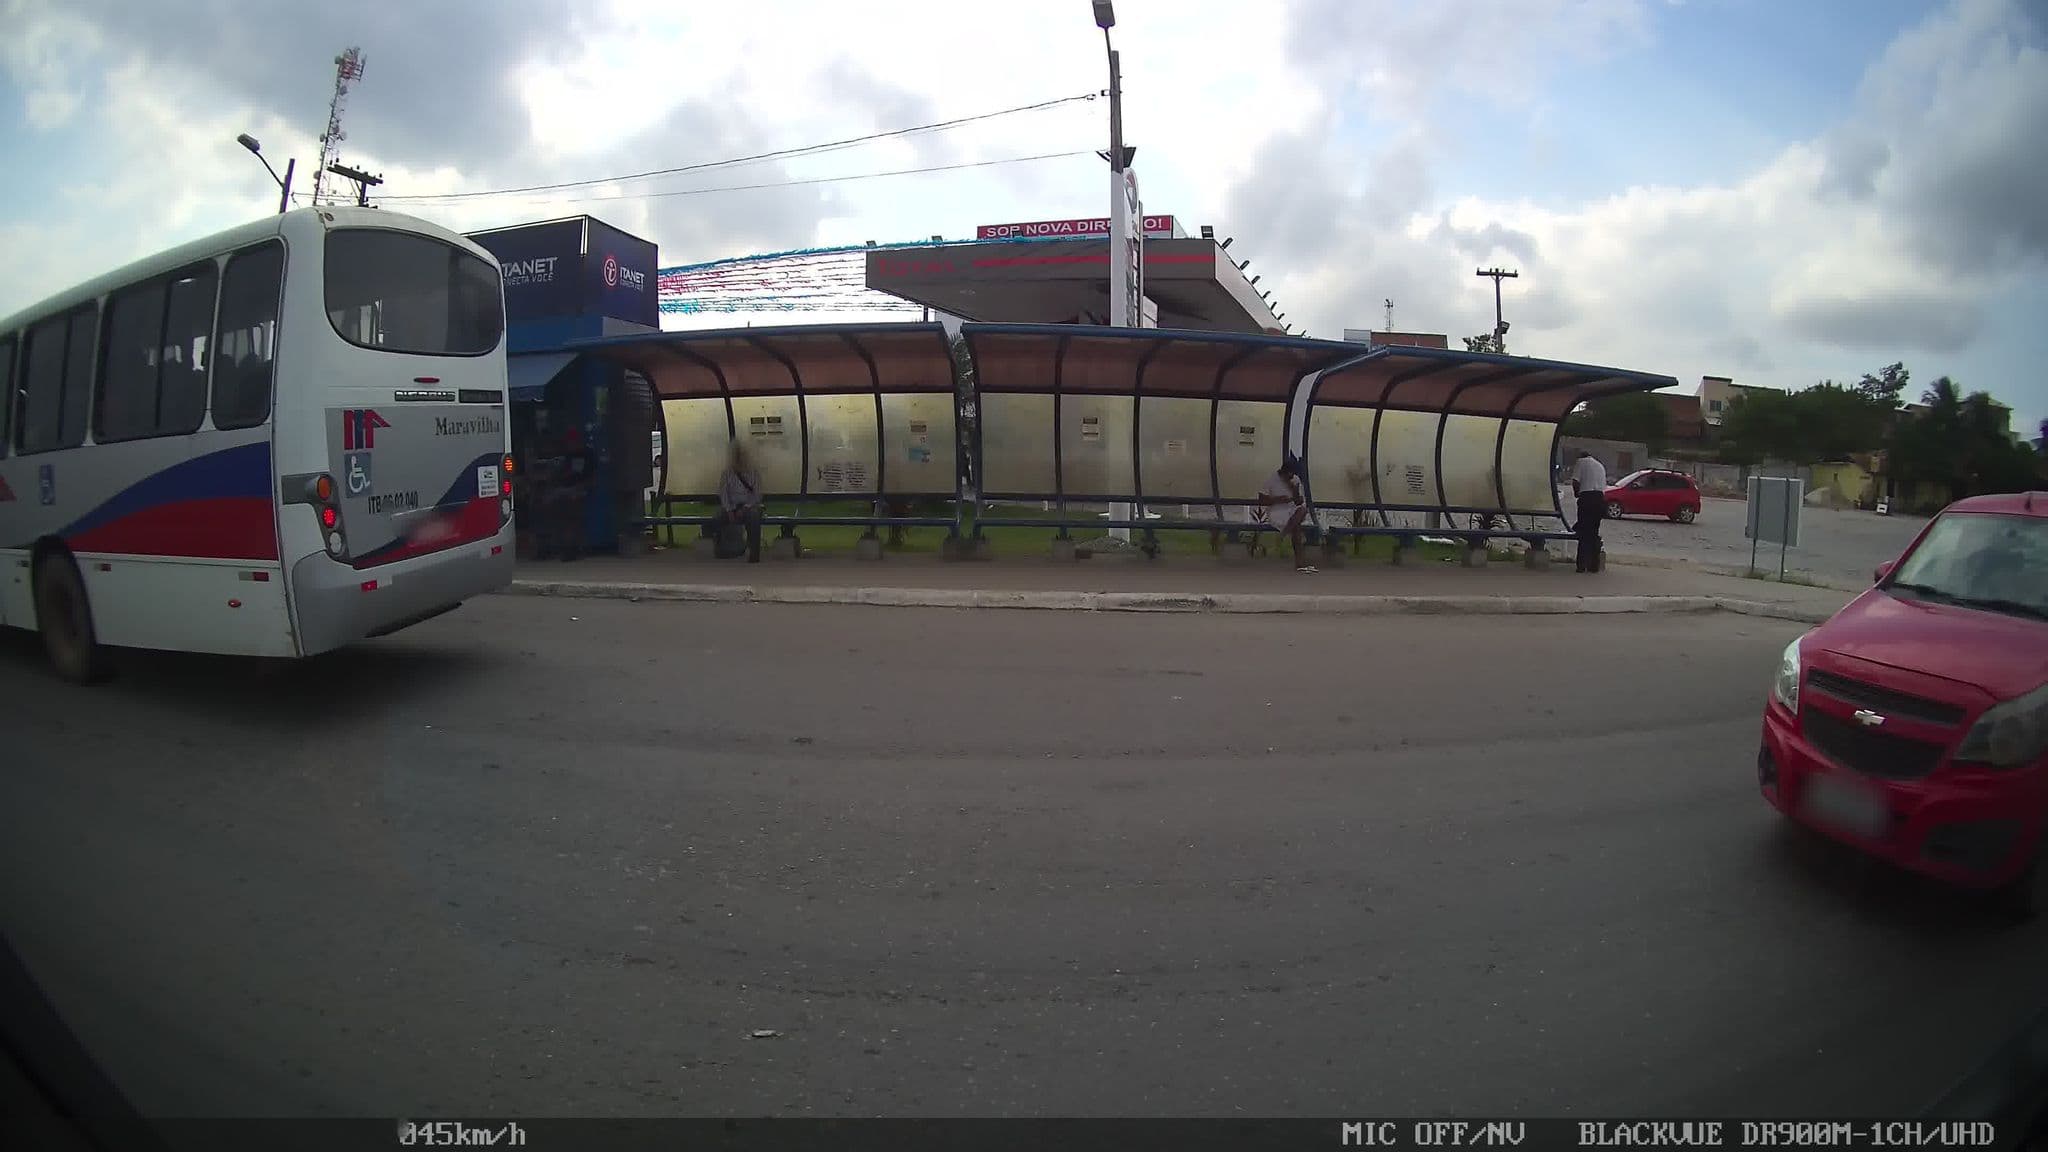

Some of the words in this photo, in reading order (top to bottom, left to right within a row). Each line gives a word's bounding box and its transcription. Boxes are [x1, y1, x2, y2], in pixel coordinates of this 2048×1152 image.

[1026, 222, 1072, 234] NOVA
[502, 257, 558, 277] TANET
[435, 416, 500, 436] Maravilha
